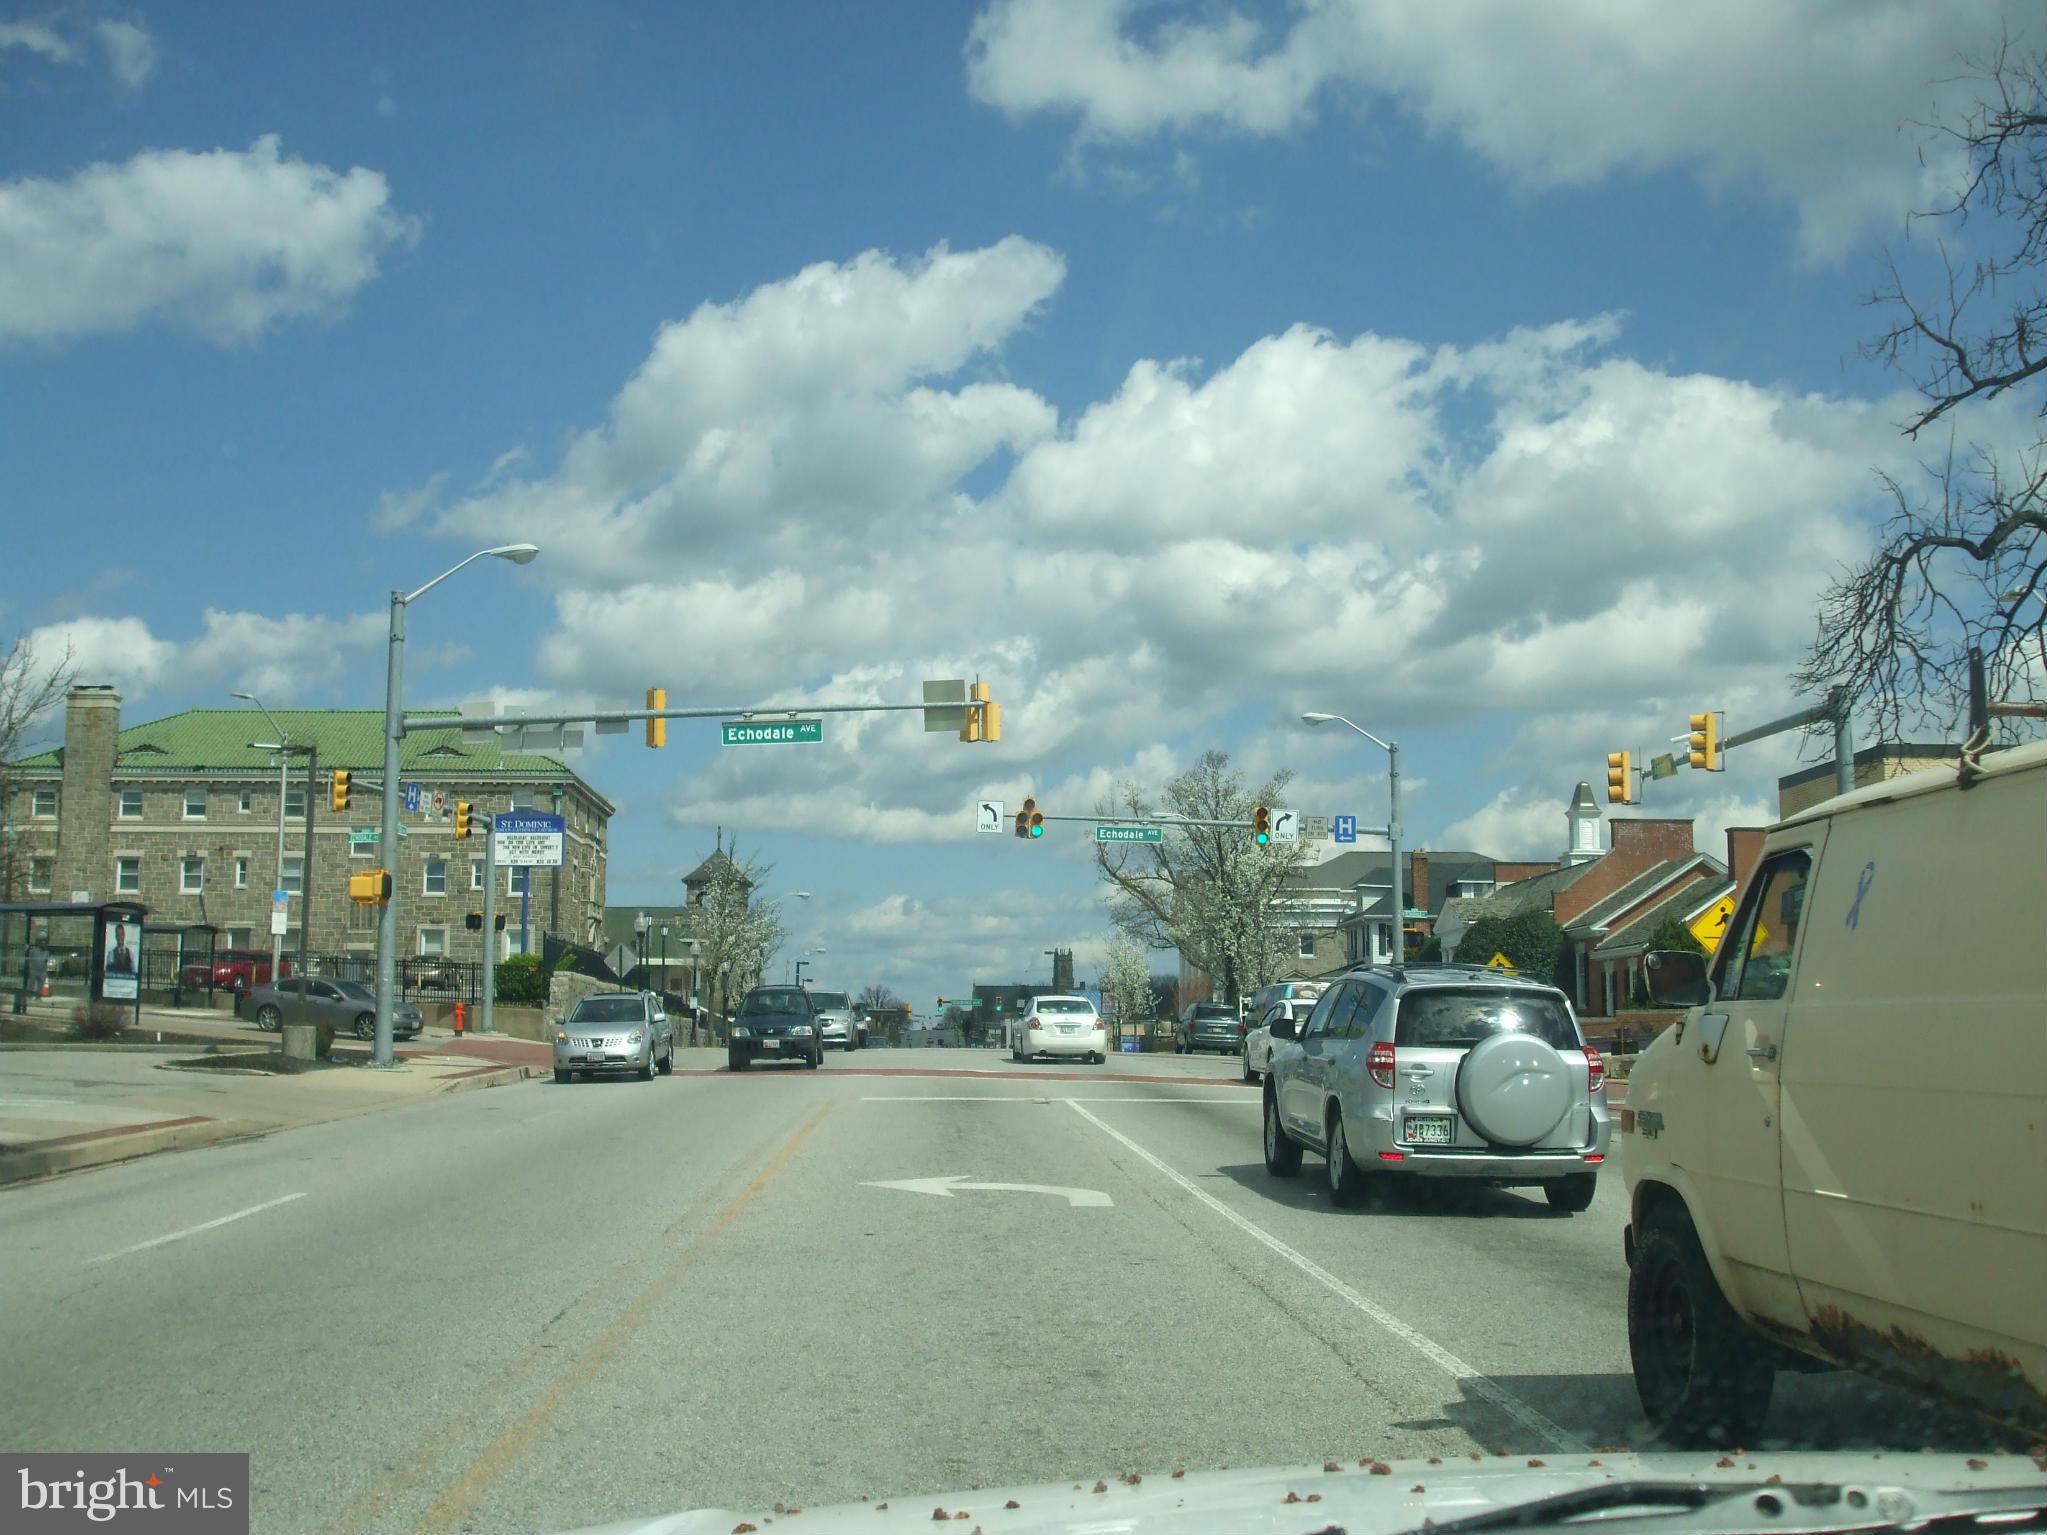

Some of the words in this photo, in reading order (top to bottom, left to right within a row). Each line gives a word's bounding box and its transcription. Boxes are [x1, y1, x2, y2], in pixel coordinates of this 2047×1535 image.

[728, 727, 795, 741] Echodale
[800, 724, 817, 733] AVE
[408, 786, 417, 803] H
[515, 820, 552, 828] DOMINIC
[980, 823, 1000, 831] ONLY
[1338, 818, 1353, 835] H
[1100, 829, 1144, 839] Echodale
[1274, 832, 1294, 840] ONLY
